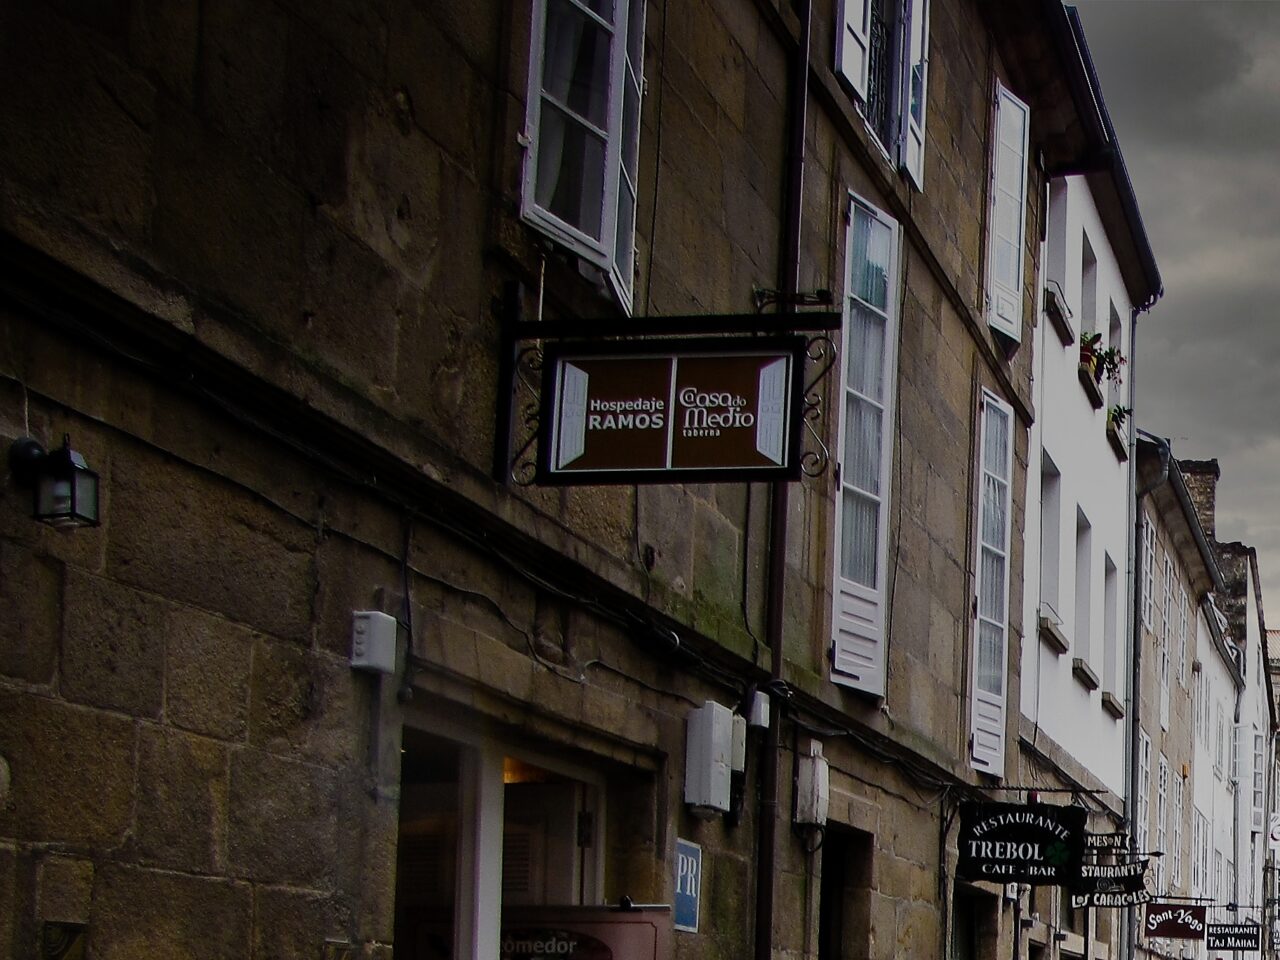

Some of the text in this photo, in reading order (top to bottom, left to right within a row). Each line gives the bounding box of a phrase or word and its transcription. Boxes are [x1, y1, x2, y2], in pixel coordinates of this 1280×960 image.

[590, 397, 665, 413] Hospedaje
[679, 387, 747, 408] Casa do
[588, 413, 664, 430] RAMOS
[683, 407, 755, 429] Medio
[682, 428, 721, 437] taberna
[972, 812, 1072, 841] RESTAURANTE
[967, 839, 1044, 861] TREBOL
[1029, 865, 1057, 877] BAR
[1081, 862, 1144, 878] STAURANTE
[1071, 889, 1151, 908] LOS CARACOLES
[1146, 908, 1203, 932] Sant-Yago
[1208, 925, 1258, 935] RESTAURANTE
